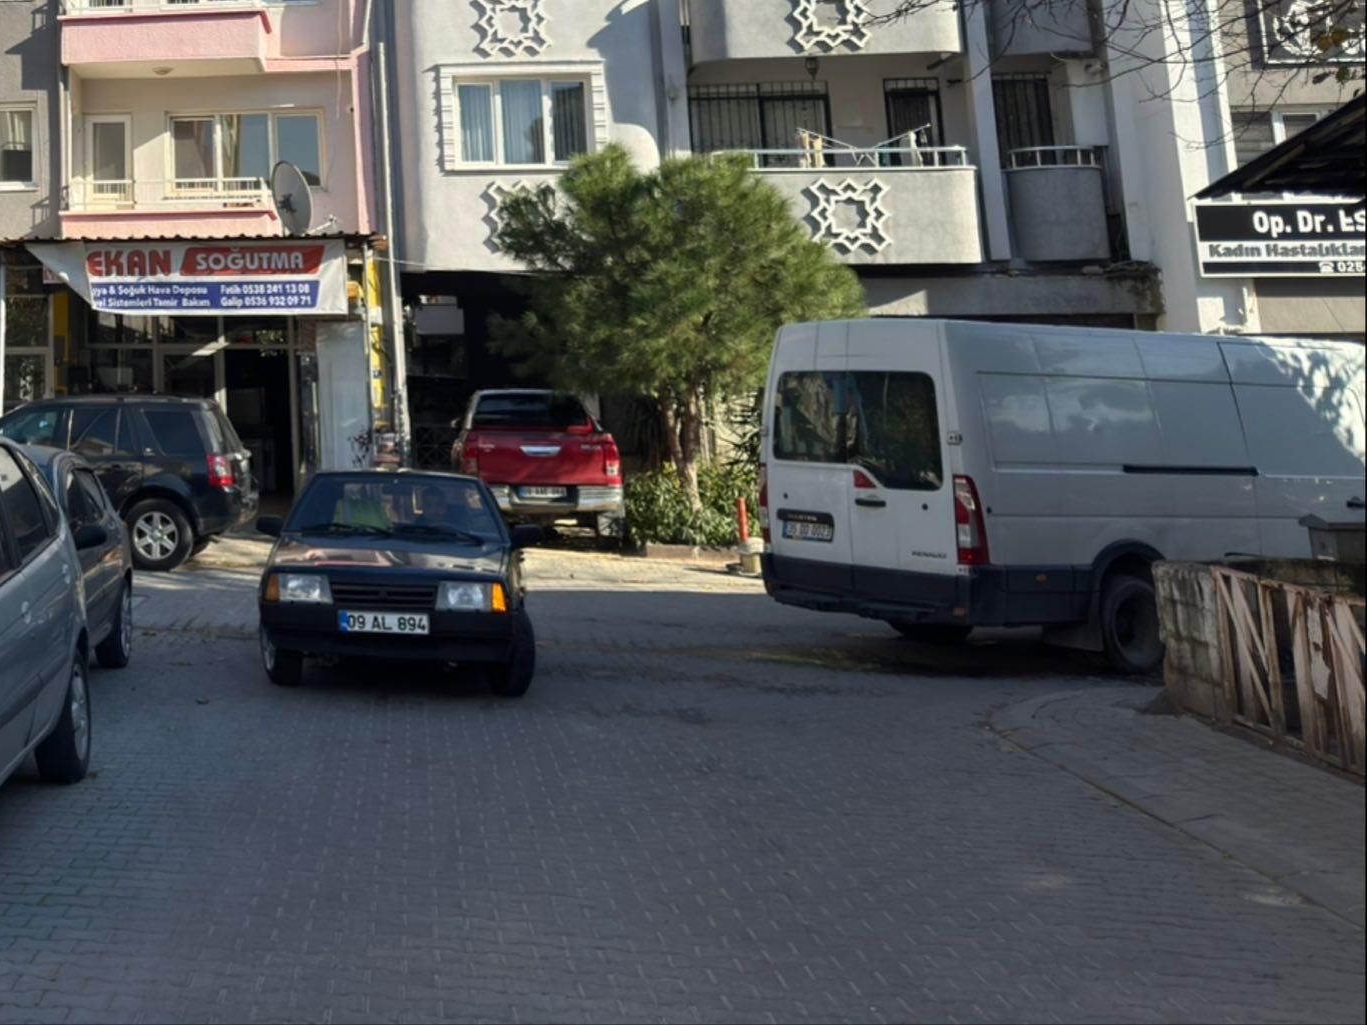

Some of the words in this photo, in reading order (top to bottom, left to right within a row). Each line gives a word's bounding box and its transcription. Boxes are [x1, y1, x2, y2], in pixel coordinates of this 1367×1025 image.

[1252, 210, 1292, 238] Op.
[1296, 209, 1334, 233] Dr.
[1208, 243, 1262, 257] Kadın
[196, 248, 304, 270] SOĞUTMA
[118, 285, 146, 297] Soğuk
[148, 285, 171, 295] Hava
[173, 285, 208, 296] Deposu
[220, 285, 242, 295] Fatih
[267, 284, 283, 294] 241
[285, 283, 297, 294] 13
[108, 297, 152, 307] Sistemleri
[153, 297, 179, 307] Tamir
[220, 297, 244, 309] Galip
[348, 614, 366, 630] 09
[372, 615, 393, 631] AL
[397, 616, 427, 632] 894
